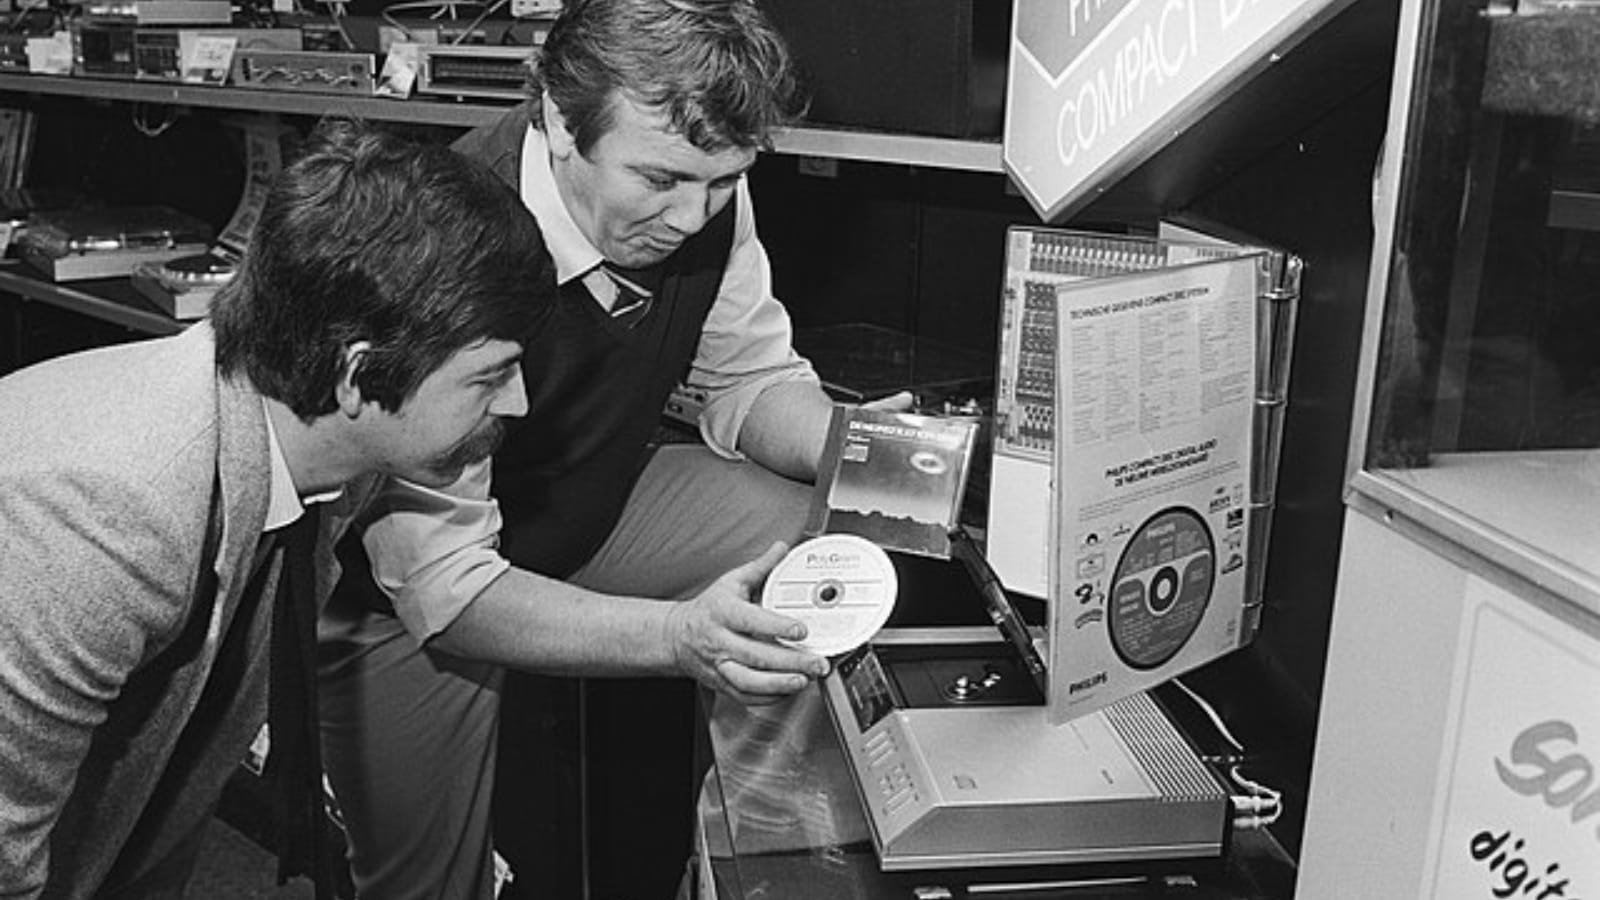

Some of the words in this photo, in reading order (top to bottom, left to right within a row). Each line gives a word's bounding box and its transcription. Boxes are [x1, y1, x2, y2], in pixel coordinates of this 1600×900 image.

[1057, 0, 1198, 166] COMPACT
[1069, 671, 1108, 695] PHILIPS
[1470, 830, 1583, 900] digit
